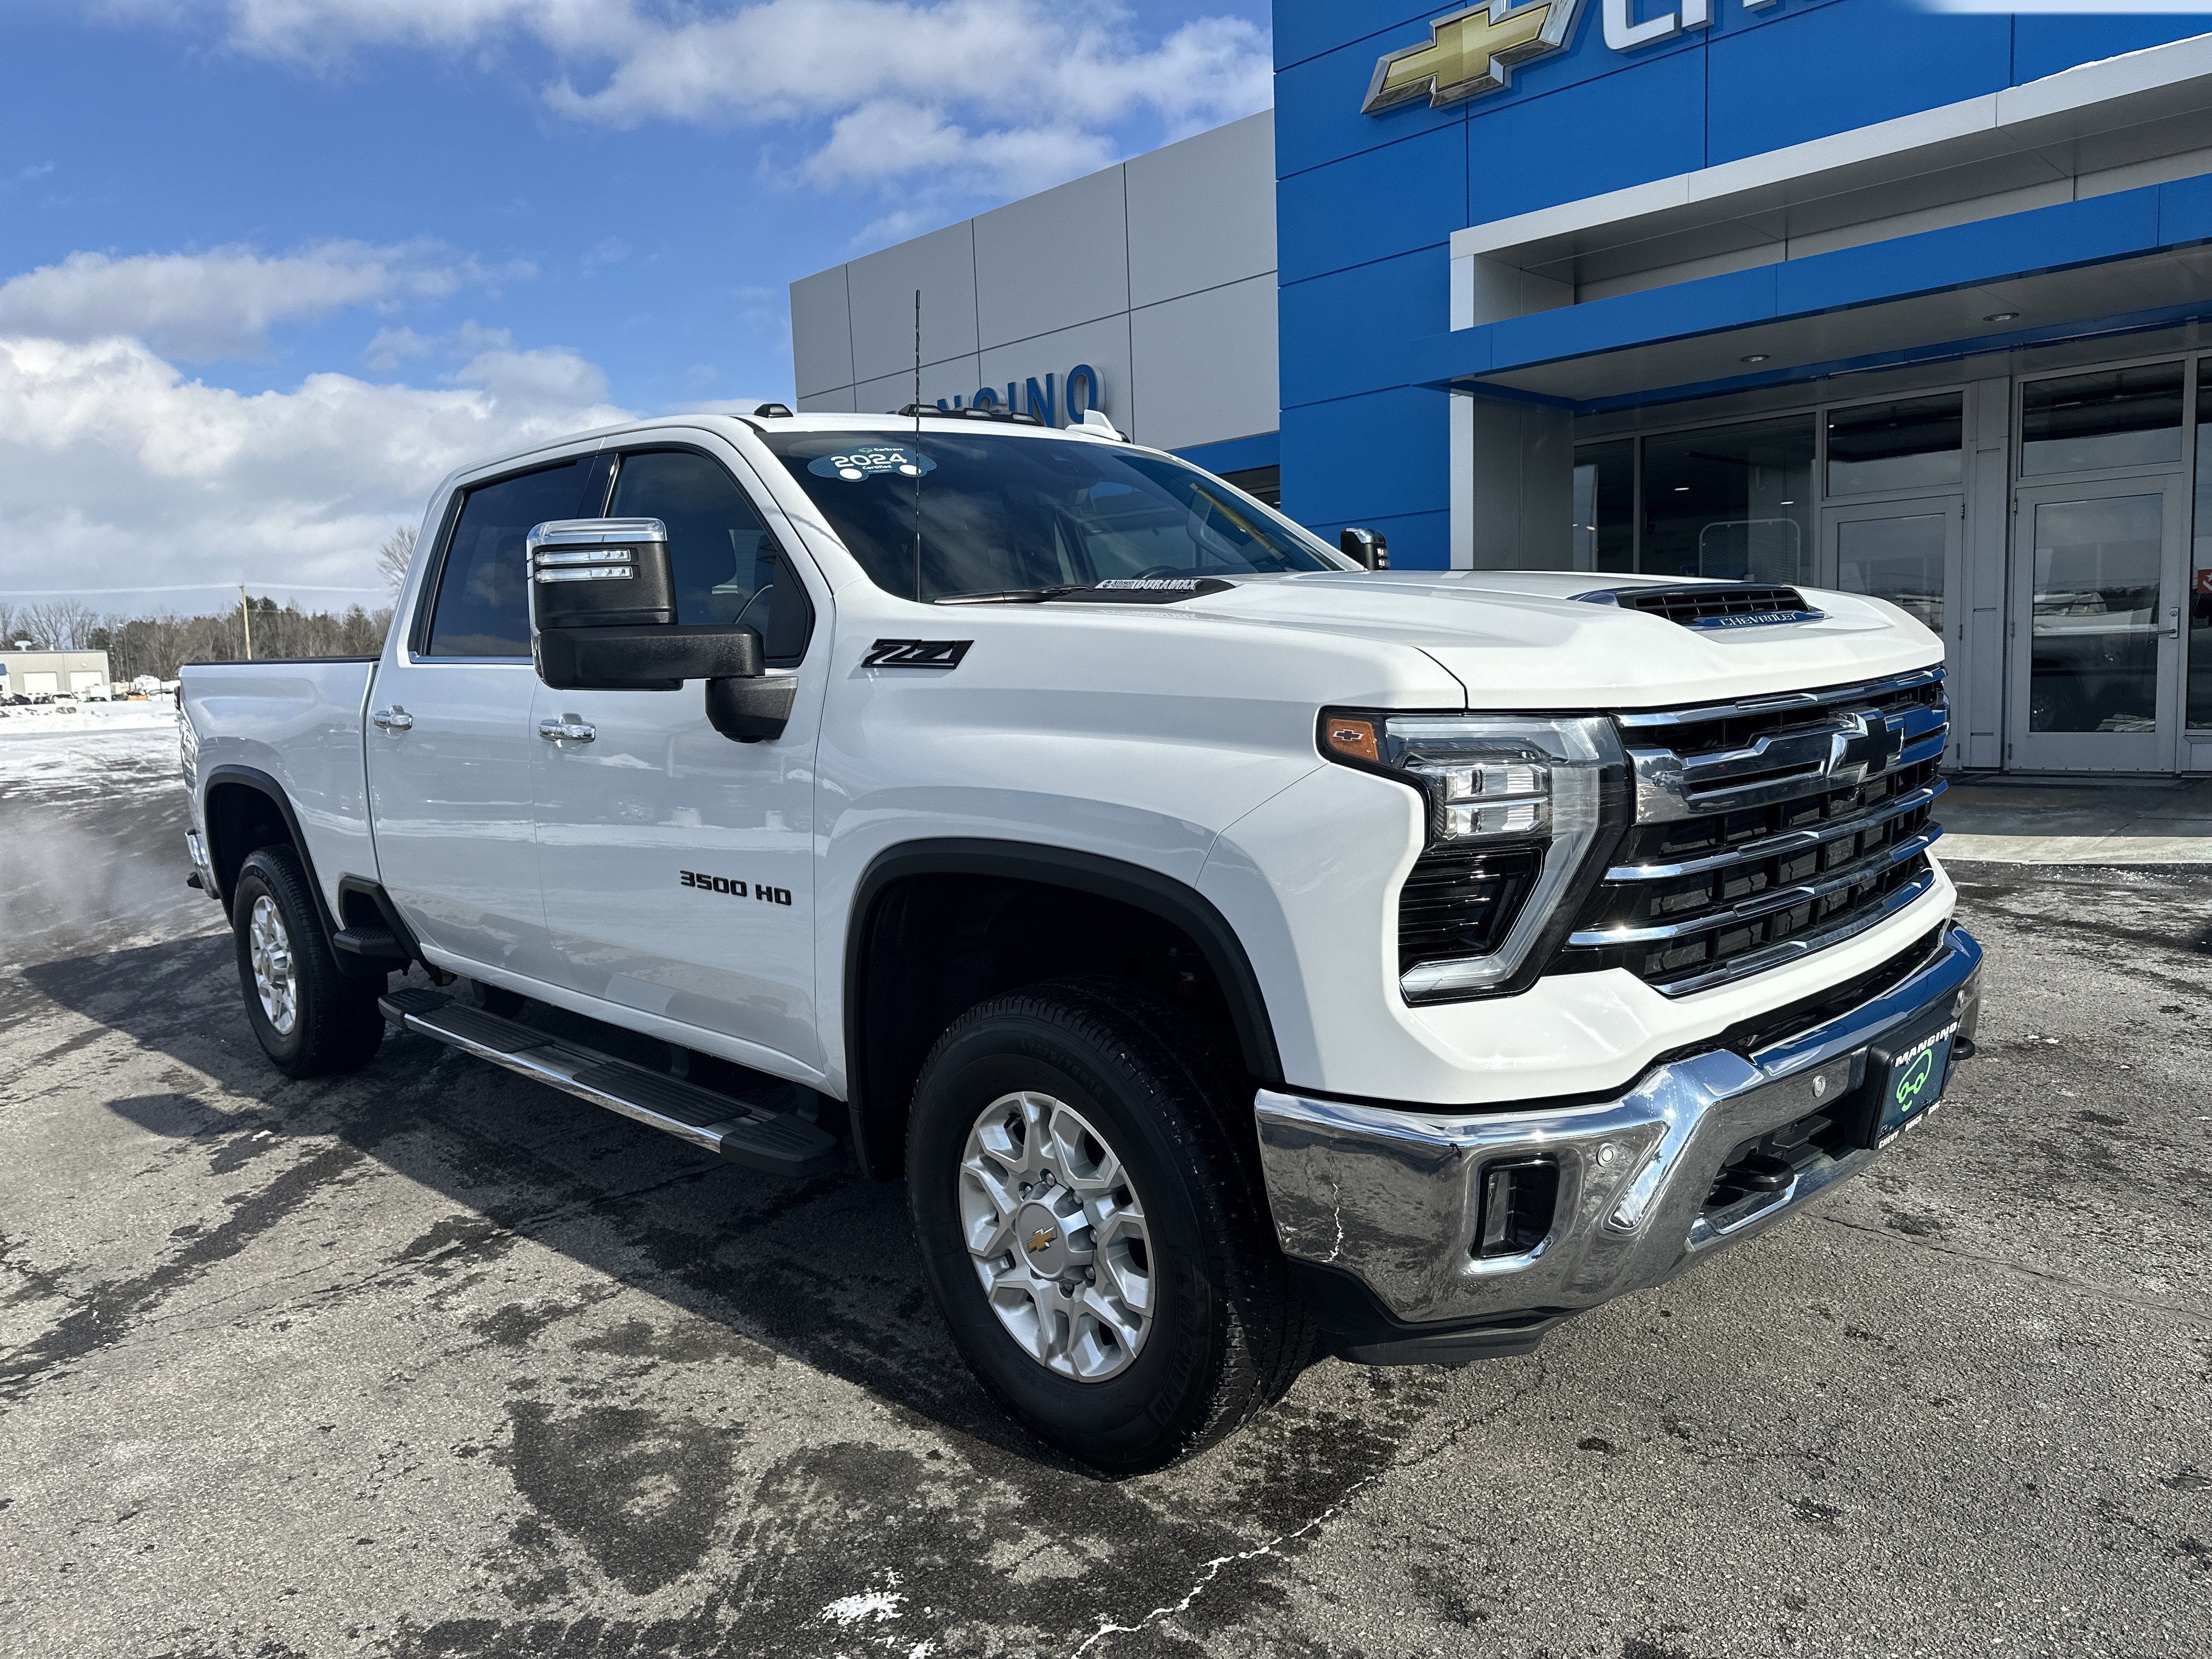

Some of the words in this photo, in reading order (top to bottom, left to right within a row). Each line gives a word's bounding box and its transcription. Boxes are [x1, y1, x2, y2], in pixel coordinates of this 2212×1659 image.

[831, 453, 907, 467] 2024
[1134, 579, 1201, 590] DURAMAX
[1720, 612, 1796, 625] CHEVROLET
[680, 870, 747, 897] 3500
[755, 884, 792, 906] HD
[1895, 1022, 1958, 1067] MANGINO
